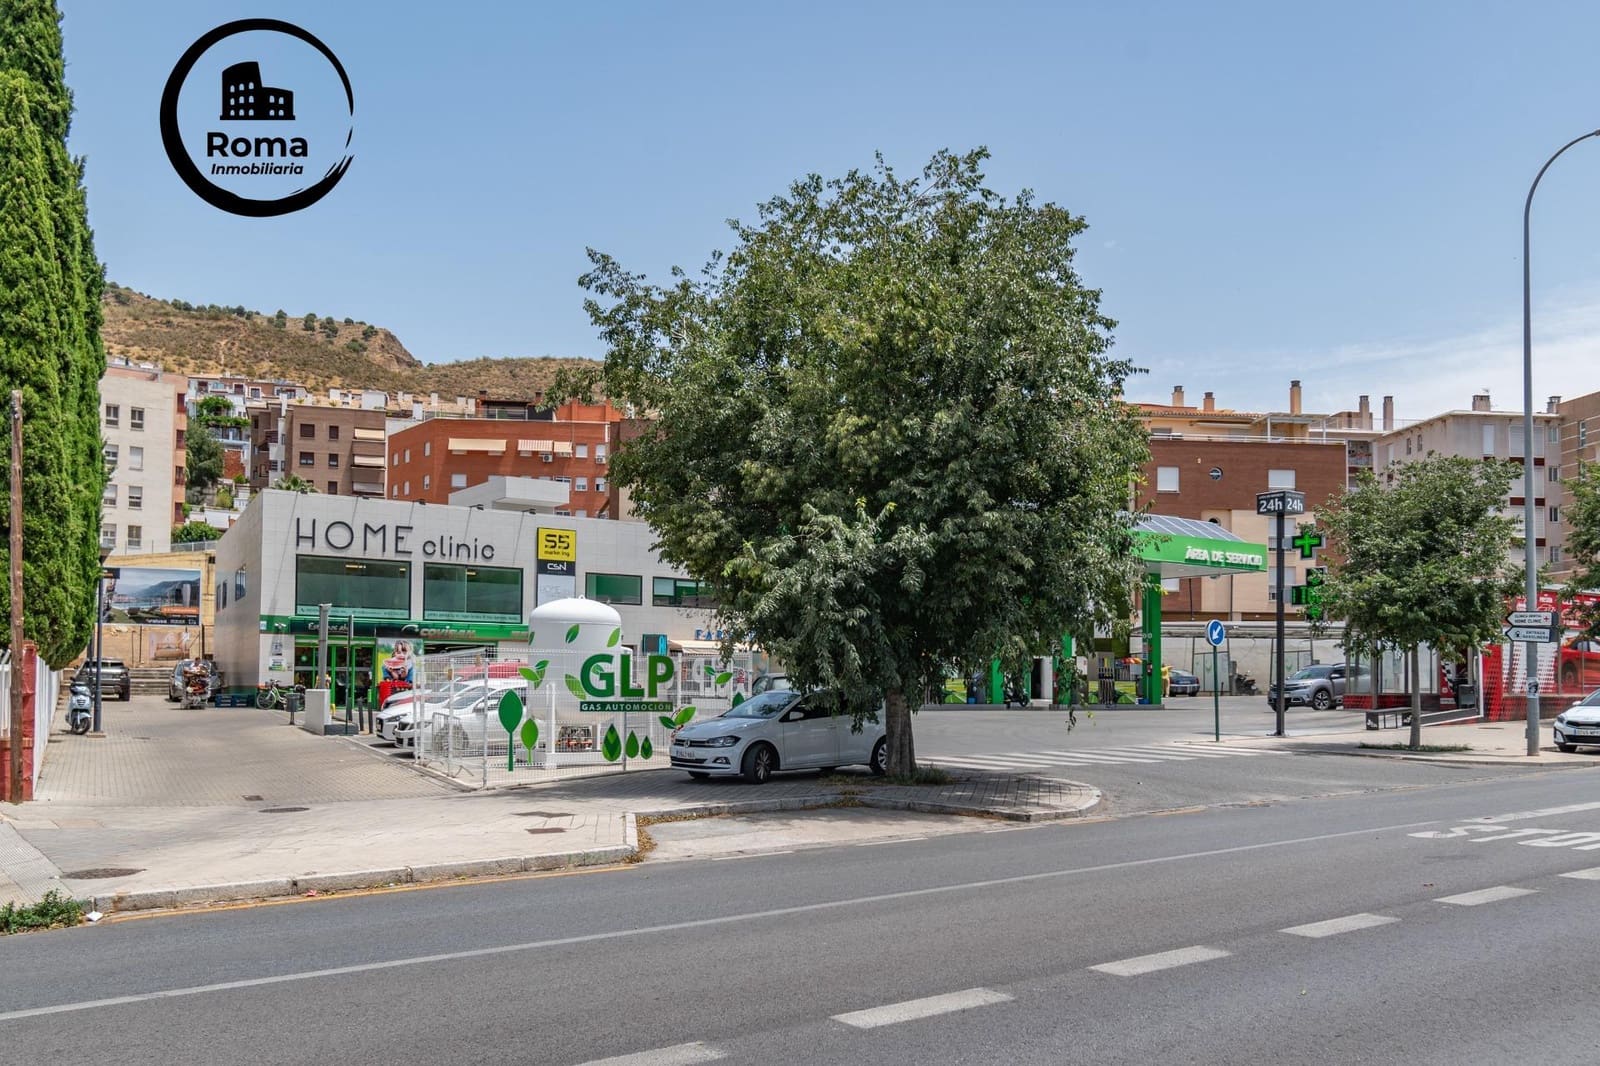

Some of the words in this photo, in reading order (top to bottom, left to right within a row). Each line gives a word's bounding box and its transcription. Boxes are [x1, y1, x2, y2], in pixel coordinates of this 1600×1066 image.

[1259, 498, 1283, 512] 24h
[1287, 498, 1303, 512] 24h
[296, 517, 413, 555] HOME
[422, 535, 495, 561] clinic
[1210, 551, 1225, 562] DE
[1225, 552, 1263, 565] SERVICIO
[547, 562, 567, 570] CSN
[580, 653, 675, 698] GLP
[581, 703, 602, 711] GAS
